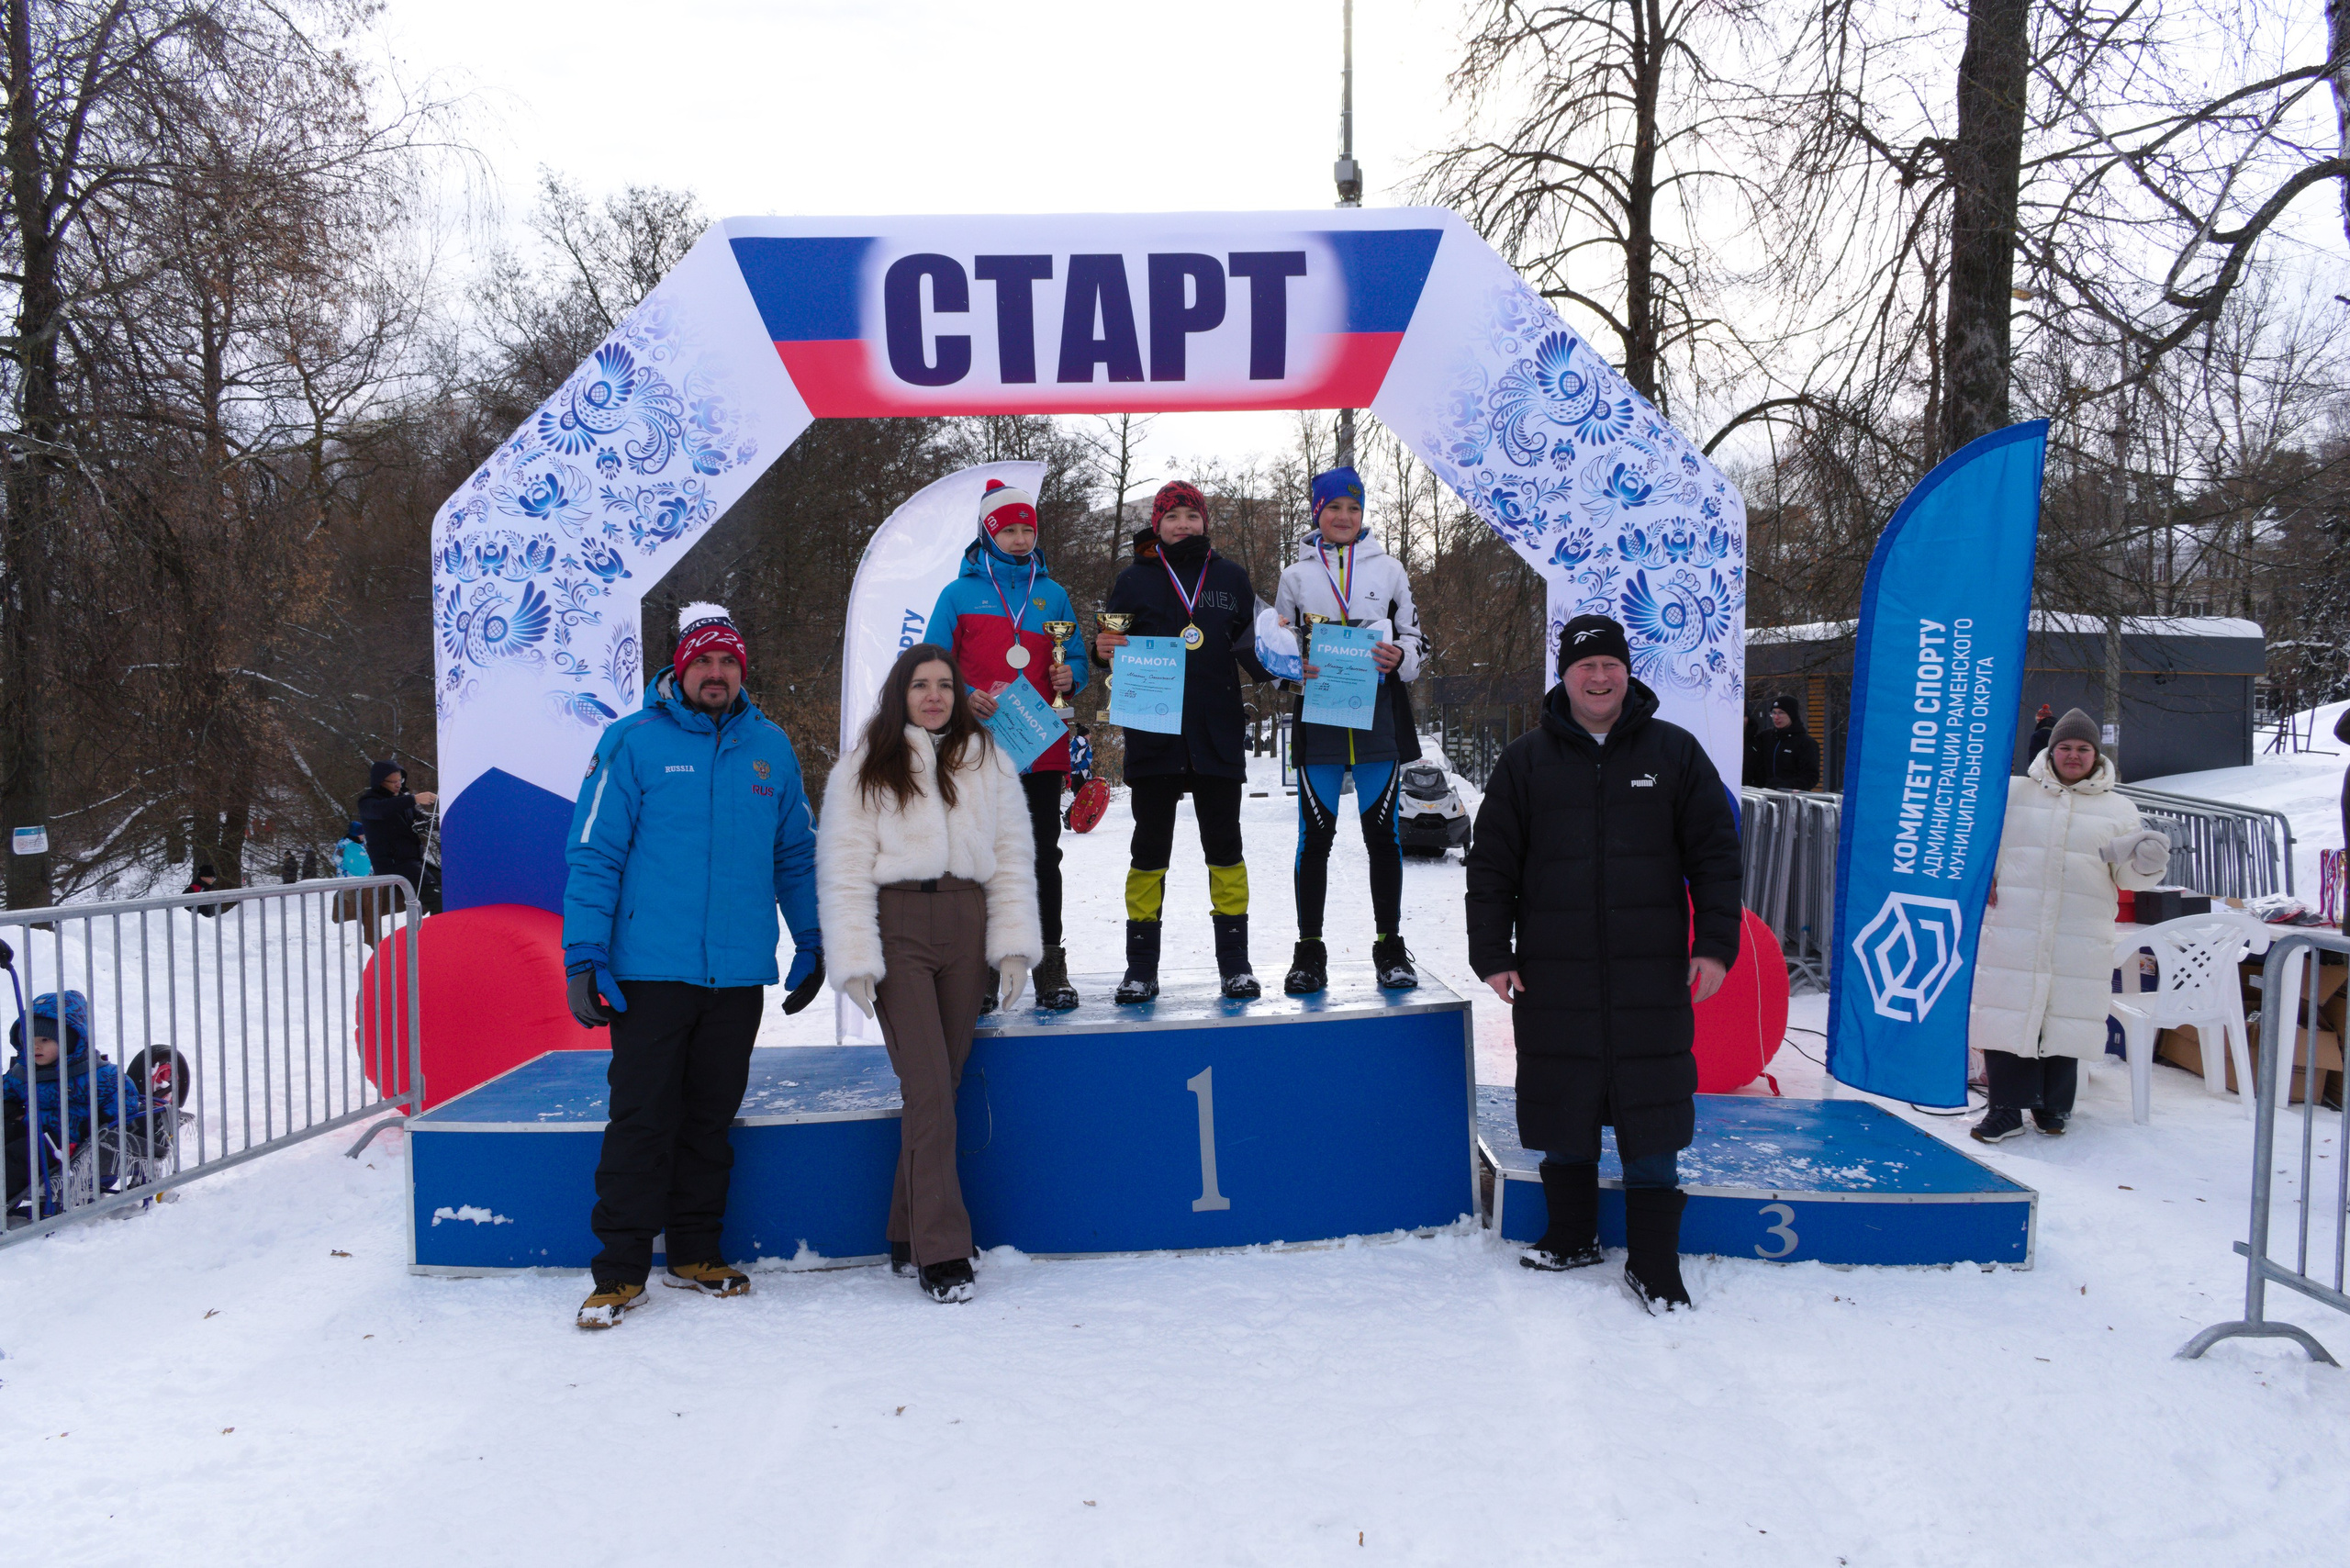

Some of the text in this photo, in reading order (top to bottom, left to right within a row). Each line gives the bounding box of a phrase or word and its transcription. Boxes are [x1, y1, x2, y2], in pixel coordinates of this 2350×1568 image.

[884, 251, 1307, 386] СТАРТ
[897, 608, 925, 659] РТУ
[1317, 644, 1373, 659] ГРАМОТА
[1121, 655, 1178, 667] ГРАМОТА
[1007, 693, 1048, 742] ГРАМОТА
[665, 765, 695, 773] RUSSIA
[1893, 618, 1946, 874] КОМИТЕТ ПО СПОРТУ
[1922, 617, 1973, 879] АДМИНИСТРАЦИИ РАМЕНСКОГО
[1947, 656, 1994, 879] МУНИЦИПАЛЬНОГО ОКРУГА
[752, 784, 775, 797] RUS
[1630, 779, 1653, 788] PUMA
[1186, 1065, 1231, 1213] 1
[1753, 1203, 1799, 1259] 3
